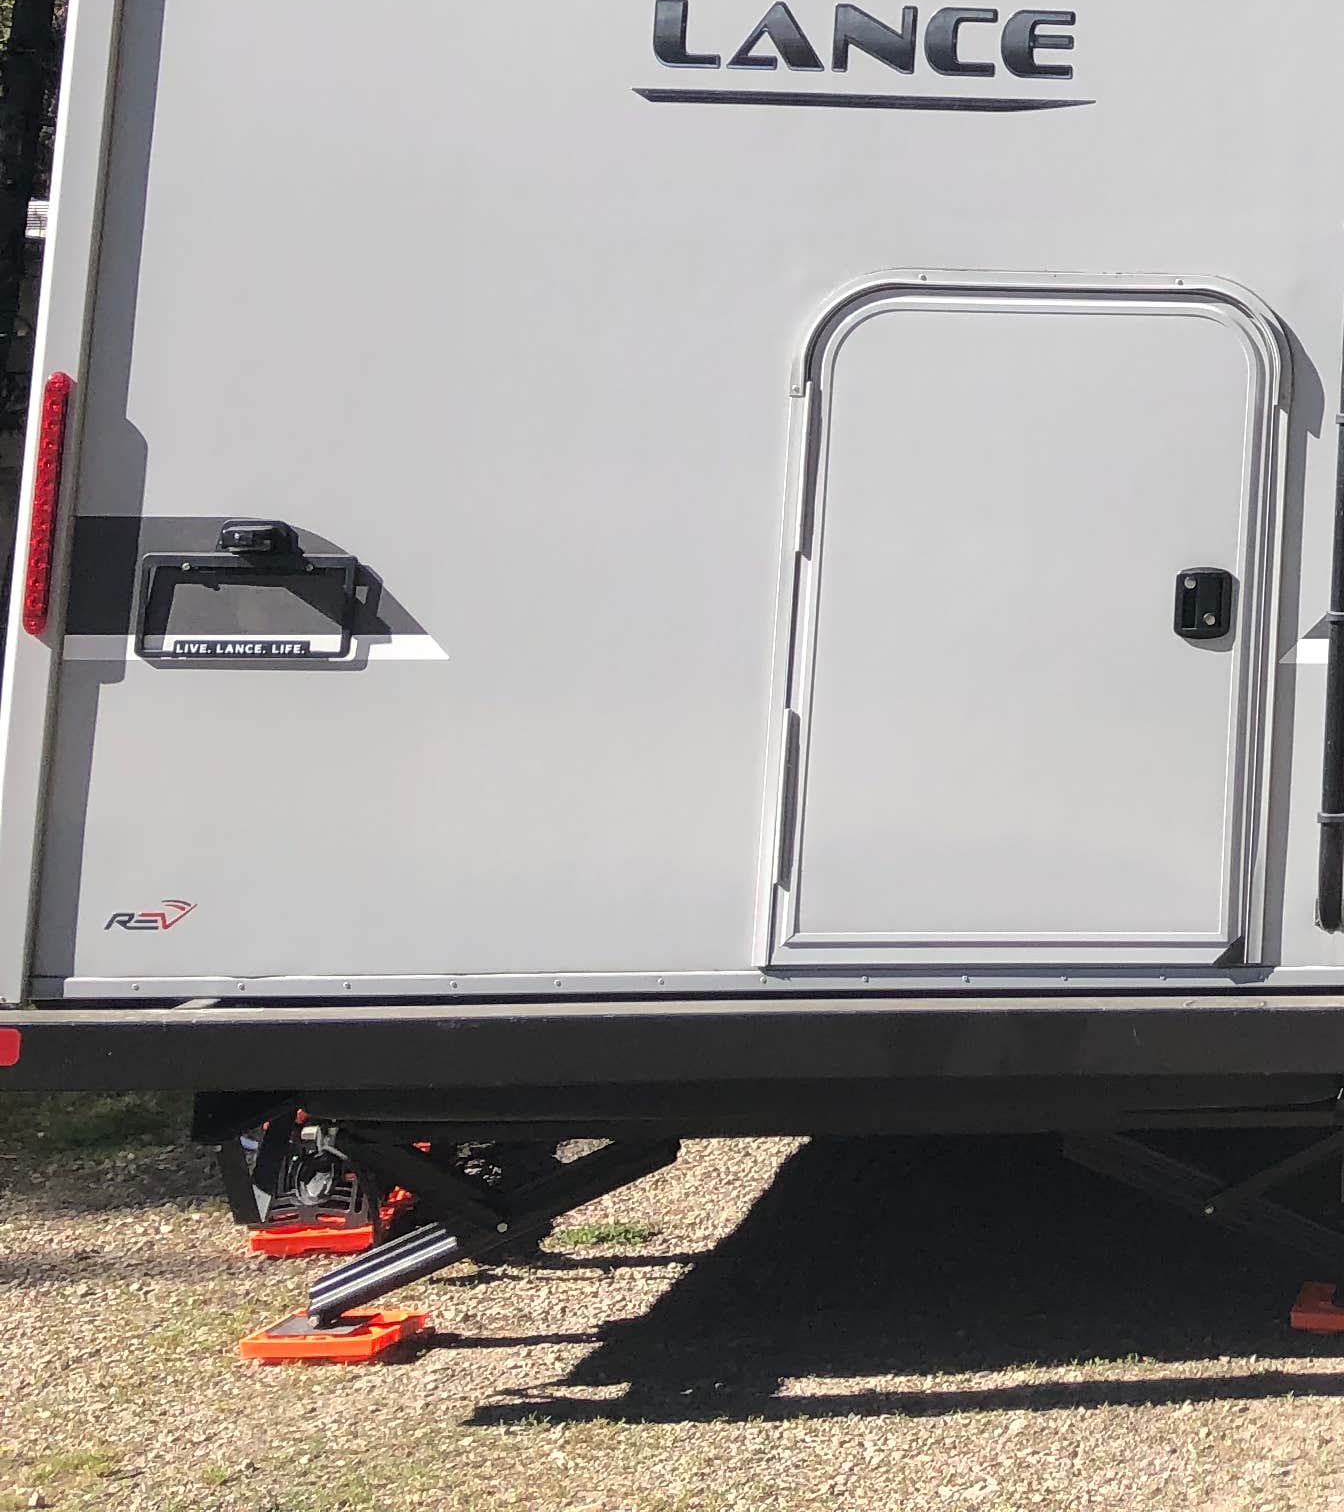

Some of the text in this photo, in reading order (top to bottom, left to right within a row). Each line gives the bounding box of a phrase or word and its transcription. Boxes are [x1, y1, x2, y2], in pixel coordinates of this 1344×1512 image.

[175, 643, 305, 654] LIVE. LANCE. LIFE.
